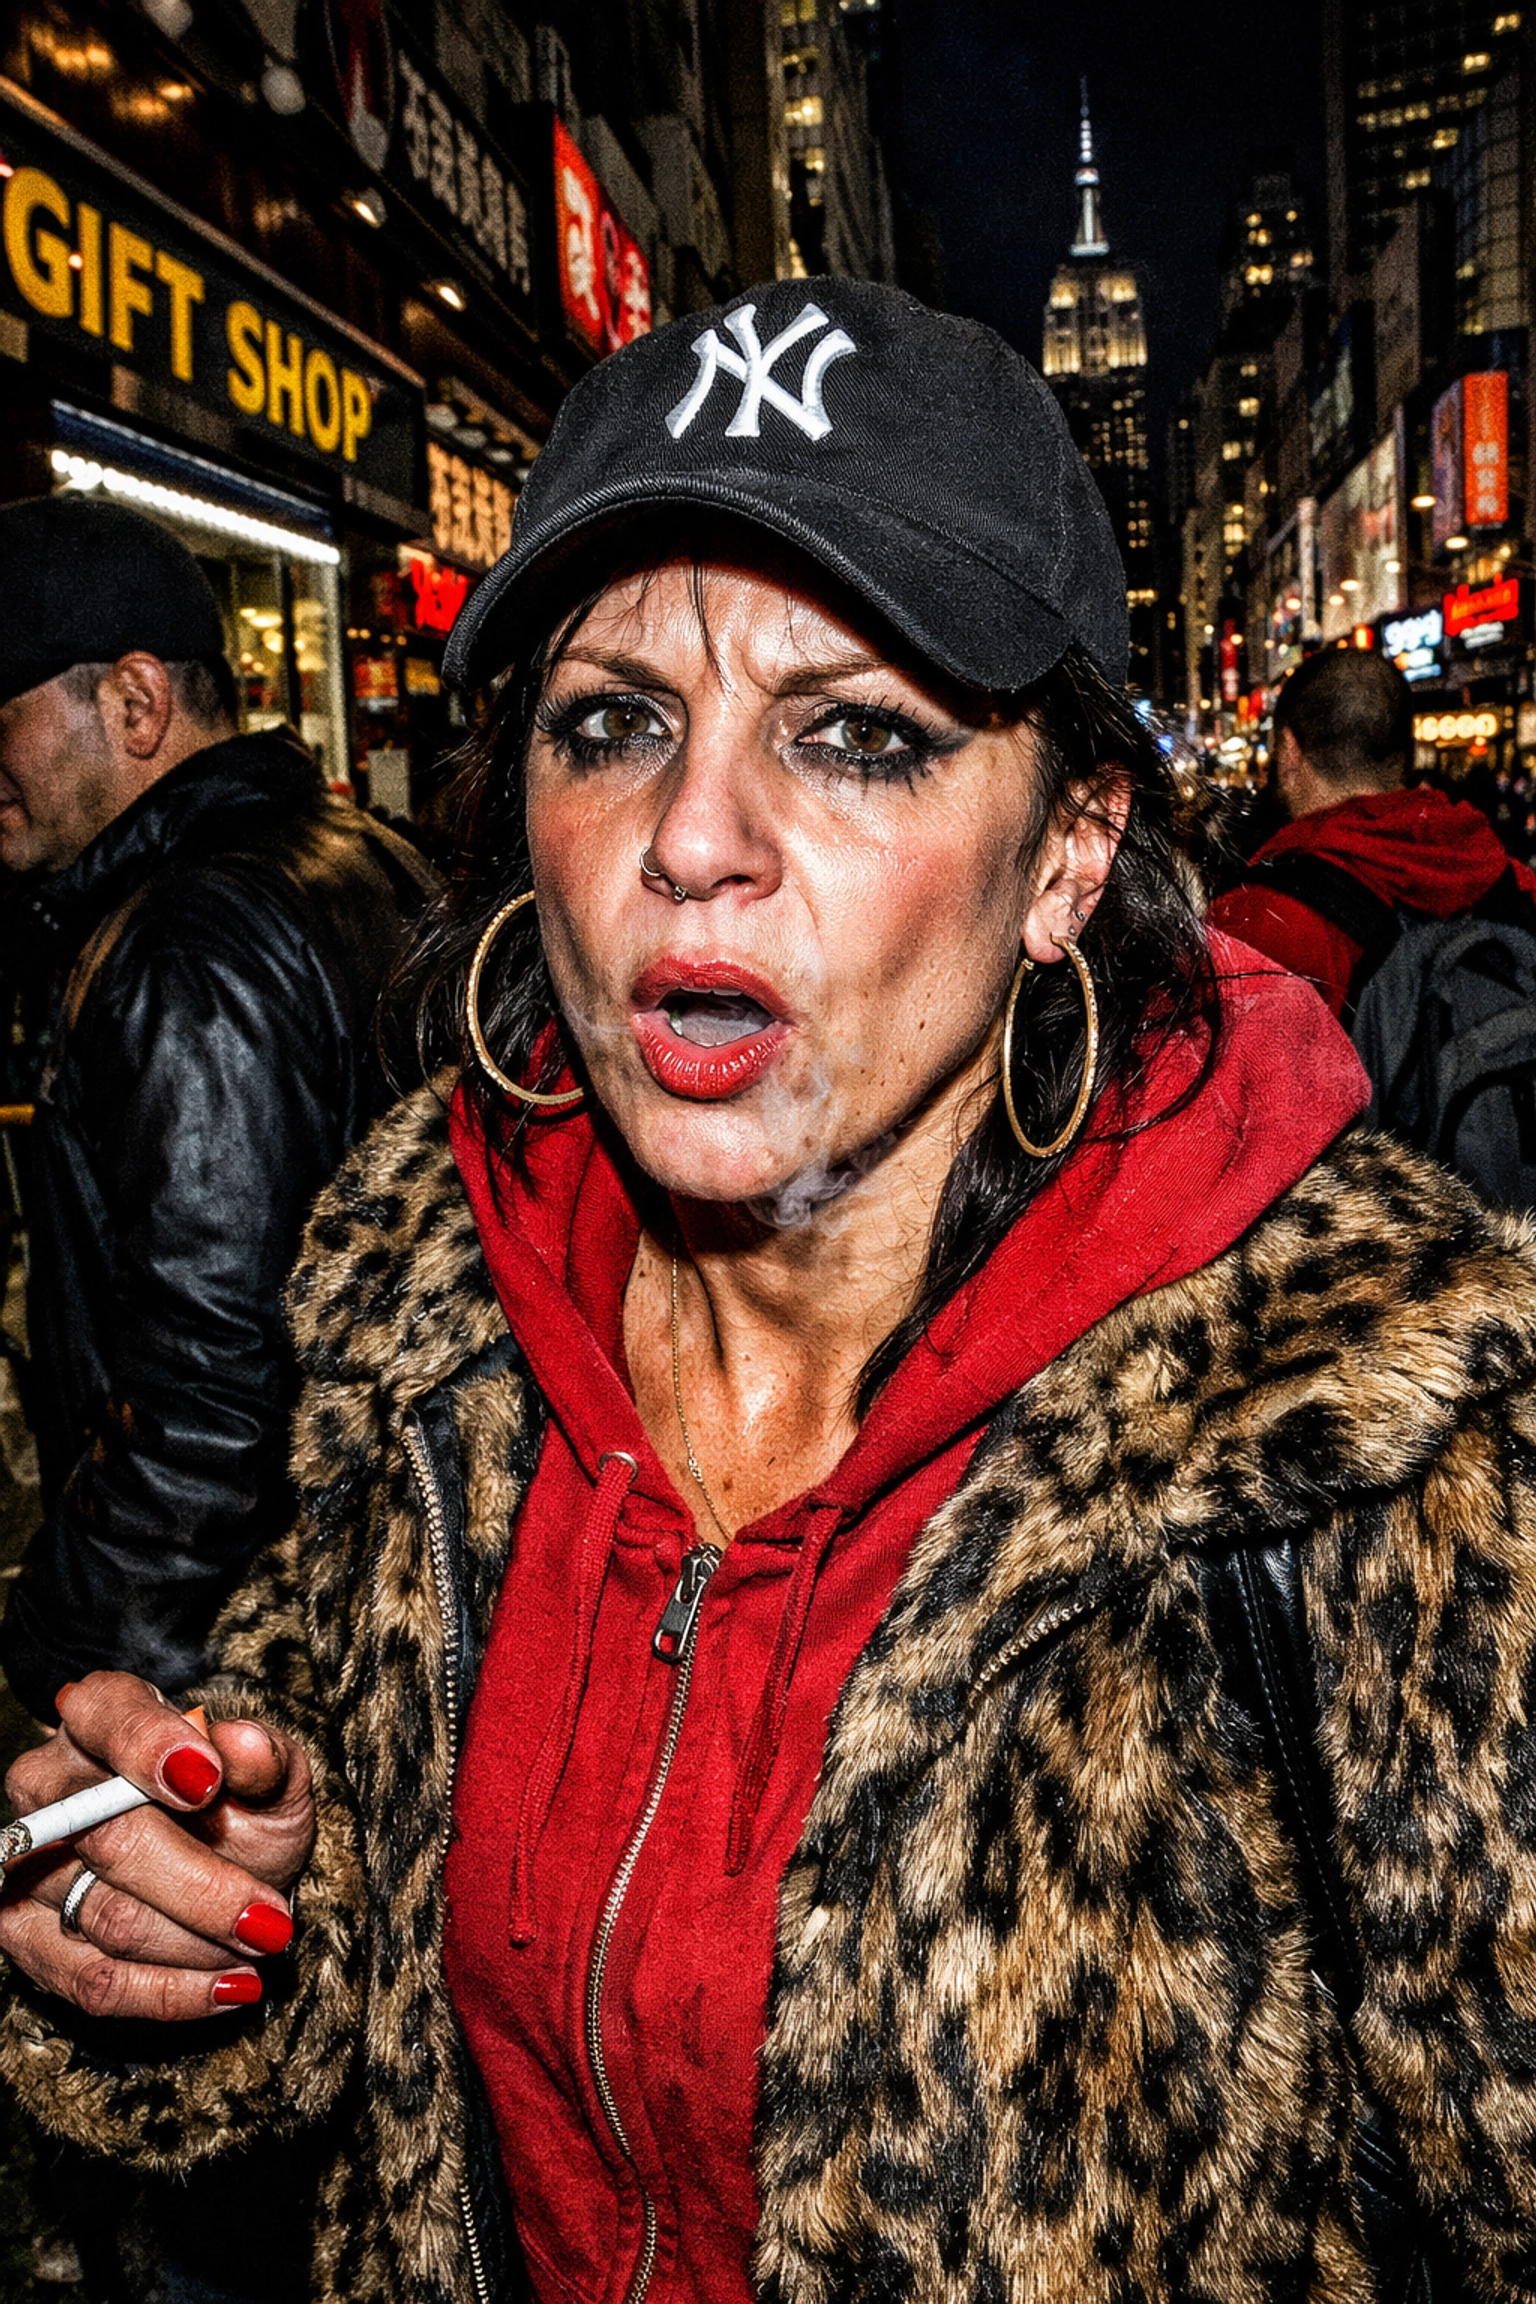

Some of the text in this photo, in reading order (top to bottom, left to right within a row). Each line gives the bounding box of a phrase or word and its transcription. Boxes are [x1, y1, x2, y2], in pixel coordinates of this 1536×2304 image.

[4, 167, 204, 381] GIFT
[227, 301, 371, 462] SHOP
[665, 303, 857, 441] NY
